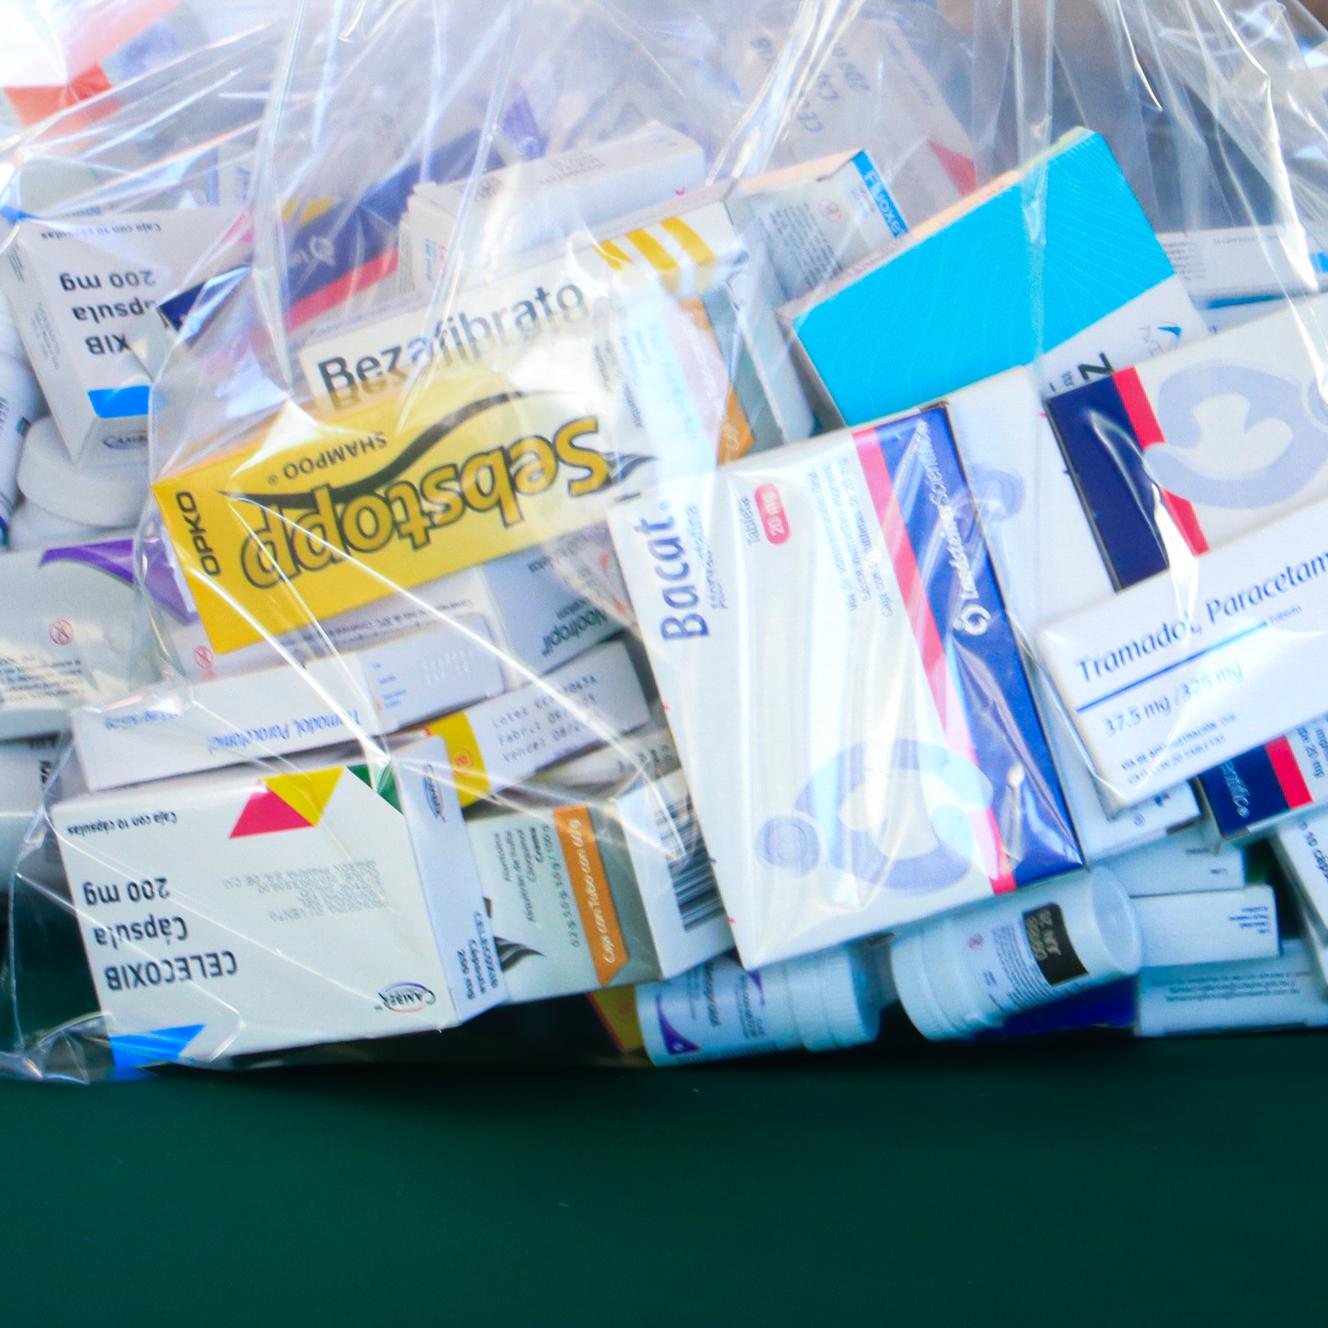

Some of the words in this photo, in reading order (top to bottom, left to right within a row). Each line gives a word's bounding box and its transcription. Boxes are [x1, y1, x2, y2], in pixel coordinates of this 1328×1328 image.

[59, 272, 101, 292] mg
[109, 270, 157, 286] 200
[318, 280, 586, 394] Bezafibrato
[283, 431, 388, 479] SHAMPOO
[240, 419, 610, 589] Sebstopp
[175, 491, 222, 577] OPKO
[638, 514, 710, 642] Bacat
[1143, 693, 1172, 720] mg
[66, 819, 115, 838] cápsulas
[117, 817, 129, 830] 10
[131, 815, 151, 826] con
[153, 810, 178, 824] Caja
[577, 848, 592, 873] con
[82, 880, 121, 906] mg
[127, 877, 171, 903] 200
[585, 875, 603, 909] Tubo
[93, 912, 189, 950] Cápsula
[595, 909, 608, 934] con
[104, 949, 239, 992] CELECOXIB
[378, 985, 437, 1012] CAMBER
